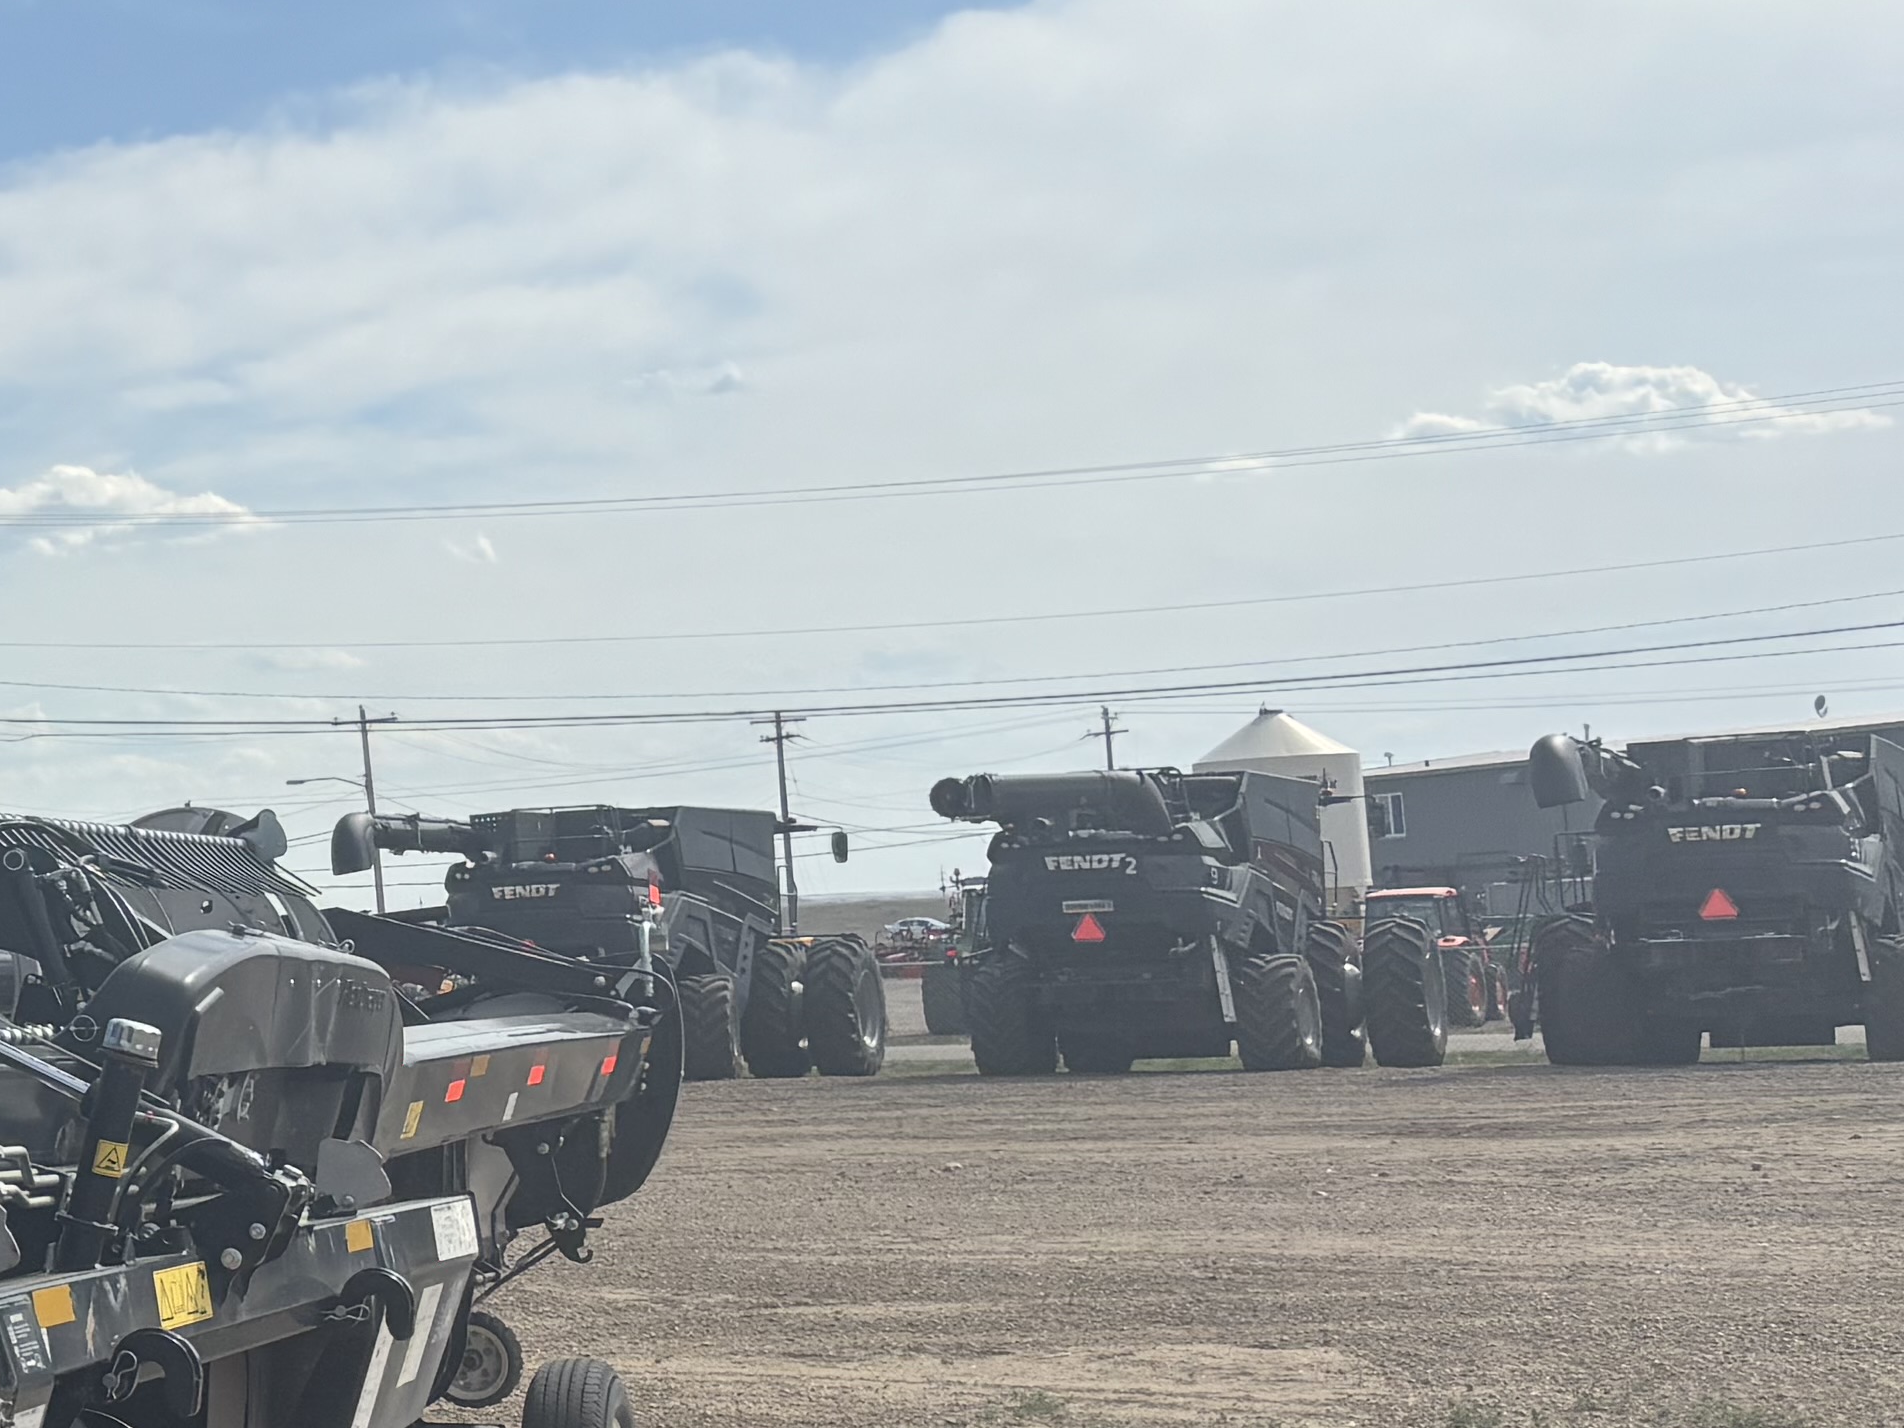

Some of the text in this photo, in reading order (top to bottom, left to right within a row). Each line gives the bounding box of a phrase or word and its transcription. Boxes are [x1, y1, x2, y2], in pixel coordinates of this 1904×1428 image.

[1667, 823, 1762, 843] FENDT
[1044, 853, 1126, 871] FENDT
[1125, 857, 1137, 874] 2
[491, 883, 561, 900] FENDT
